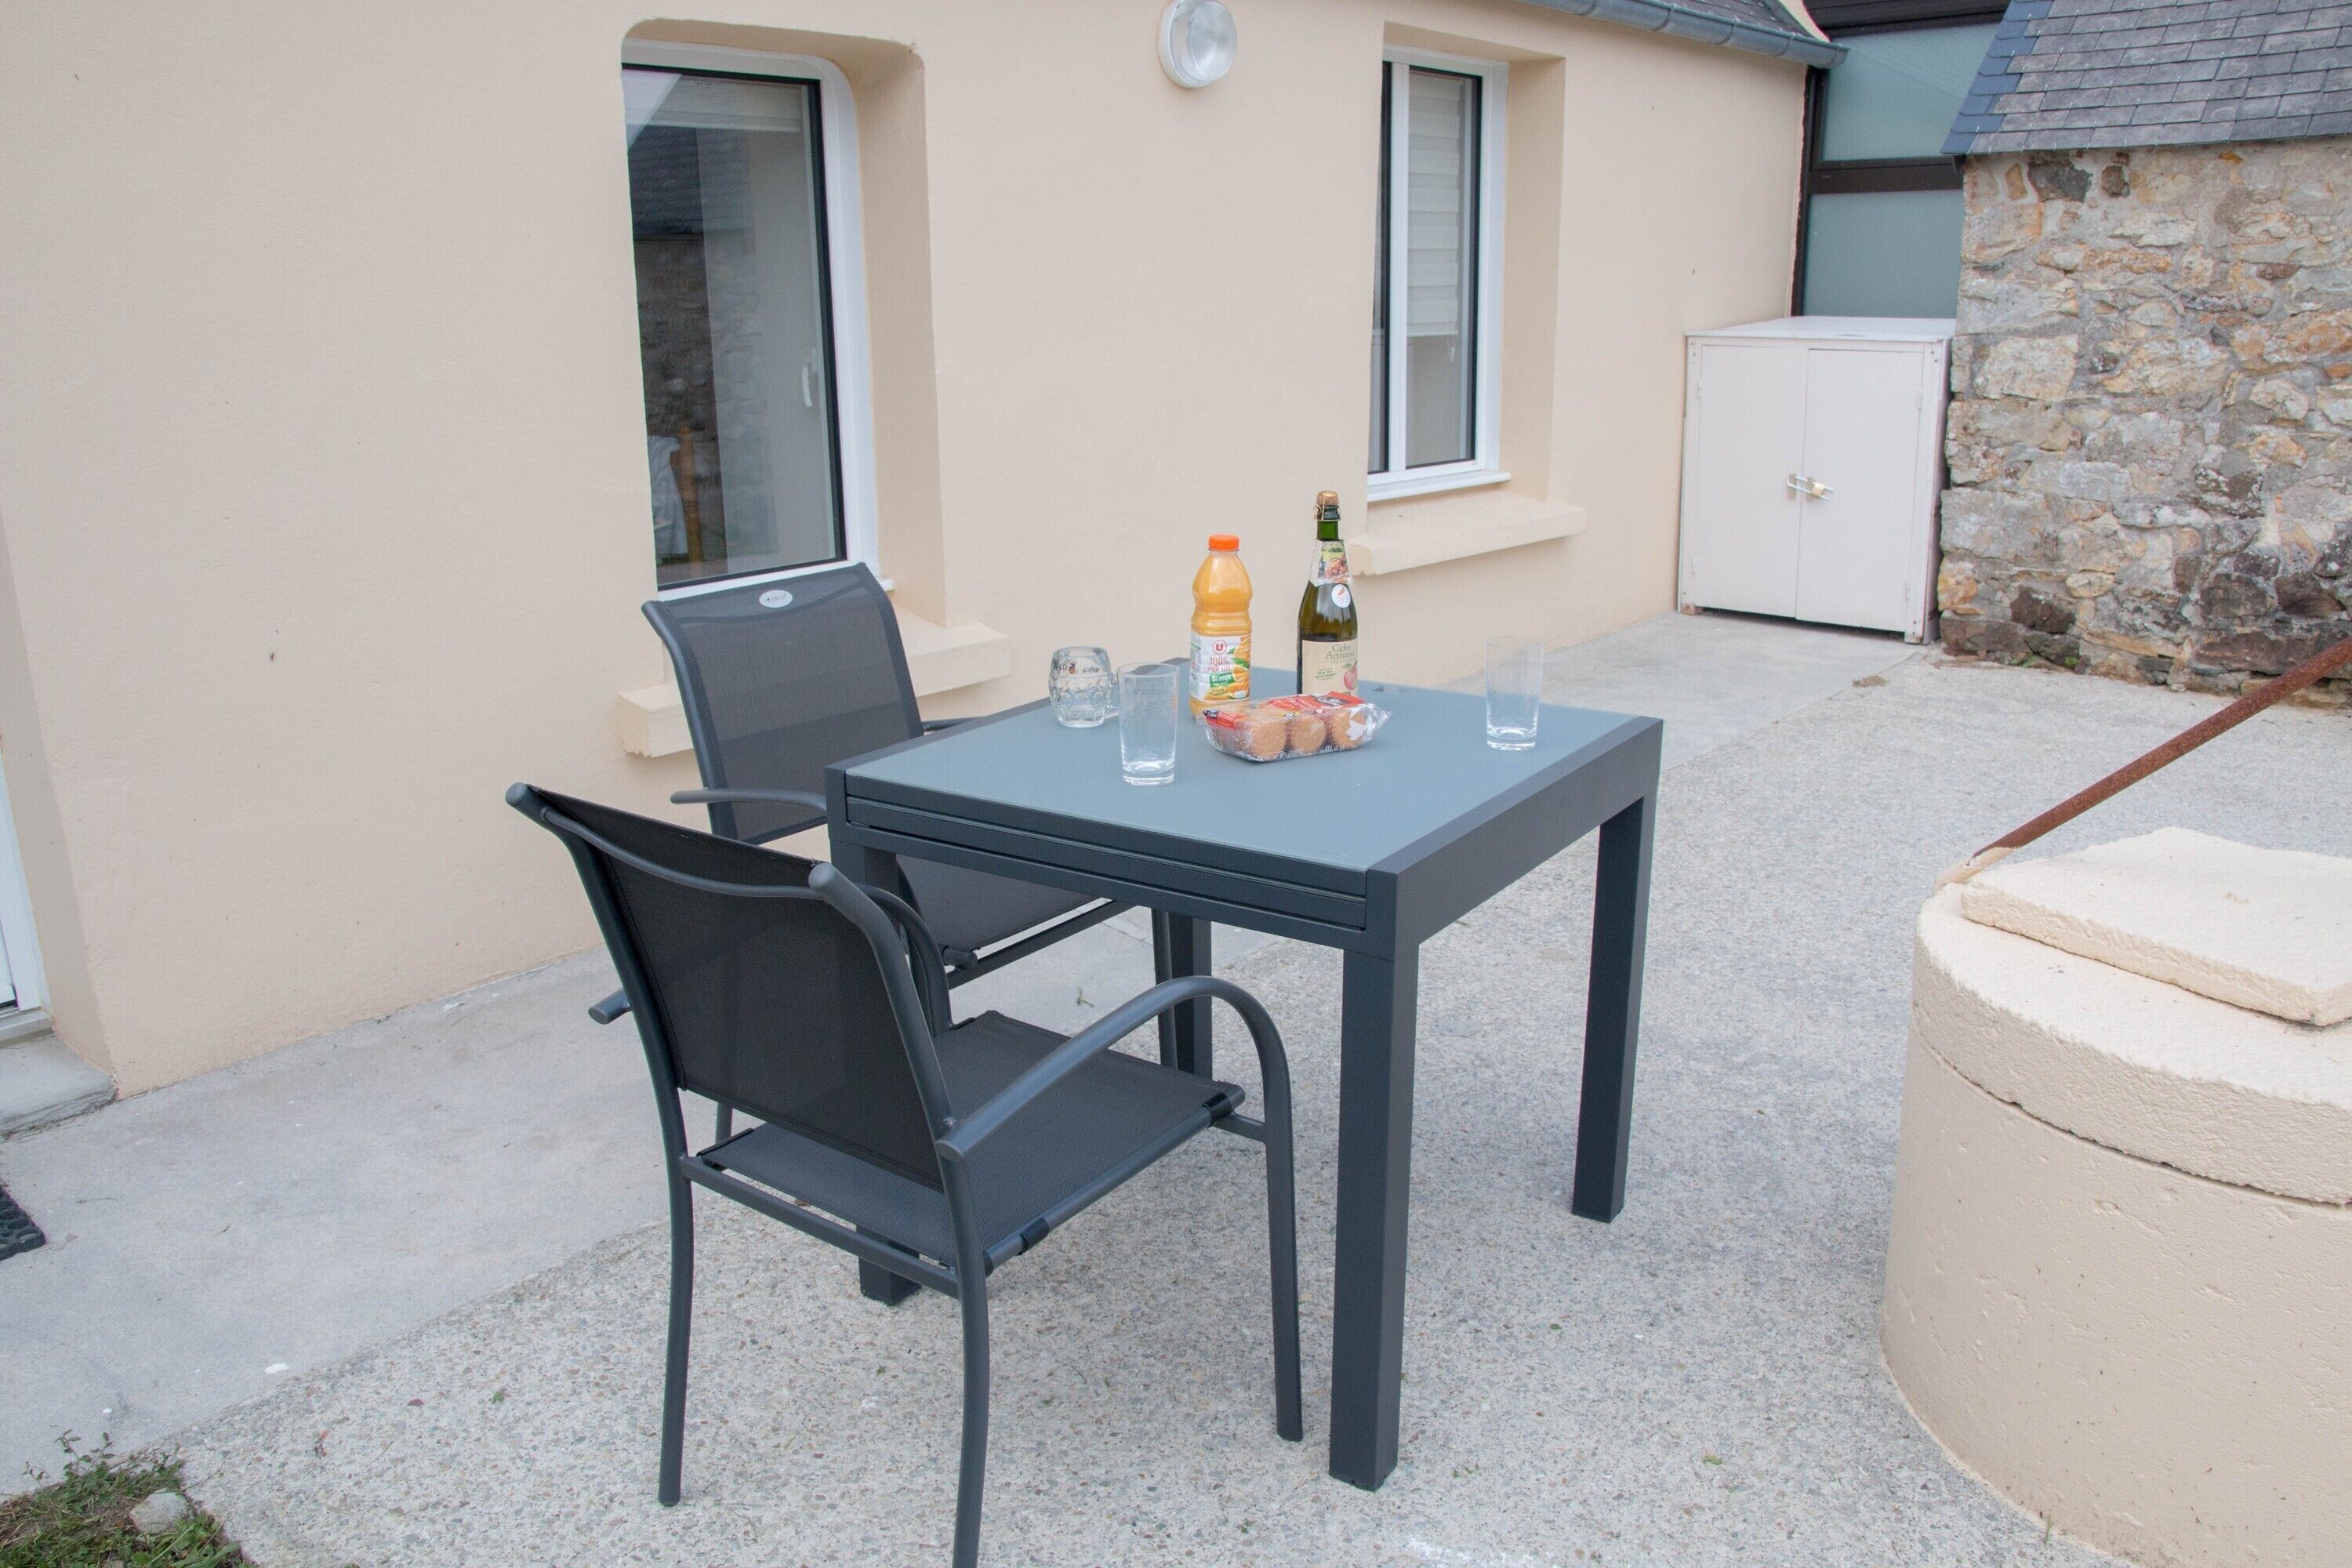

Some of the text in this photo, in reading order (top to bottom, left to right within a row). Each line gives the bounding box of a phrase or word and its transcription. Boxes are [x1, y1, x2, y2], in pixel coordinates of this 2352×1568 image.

[1332, 644, 1352, 652] Cidre
[1210, 656, 1229, 666] 100%
[1211, 673, 1232, 682] Orange
